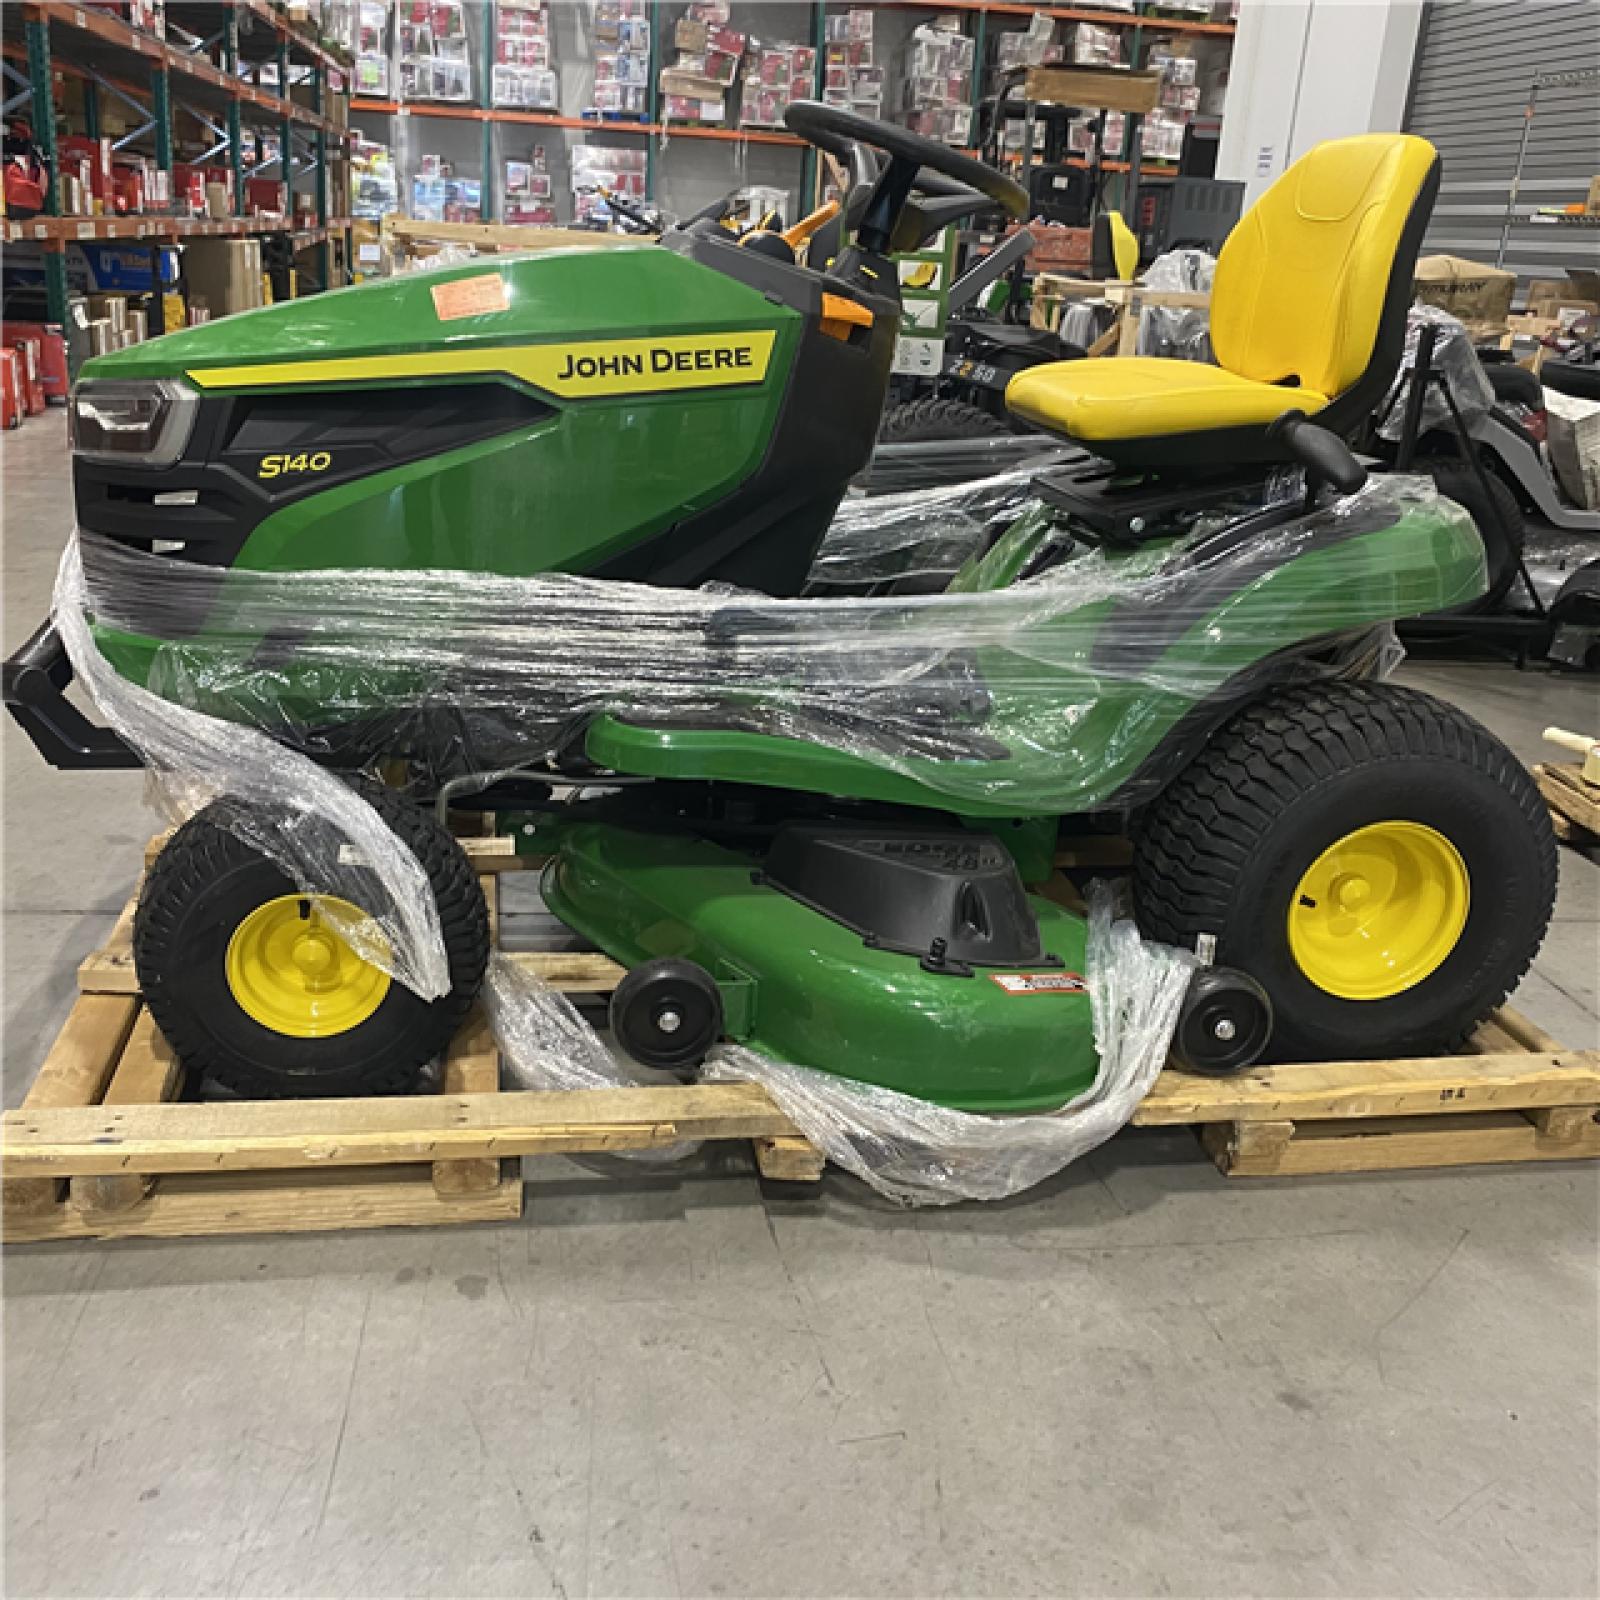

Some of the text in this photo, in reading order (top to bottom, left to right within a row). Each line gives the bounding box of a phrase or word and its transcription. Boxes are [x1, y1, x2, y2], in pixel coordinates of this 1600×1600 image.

[558, 347, 753, 380] JOHN DEERE
[258, 451, 331, 477] S140
